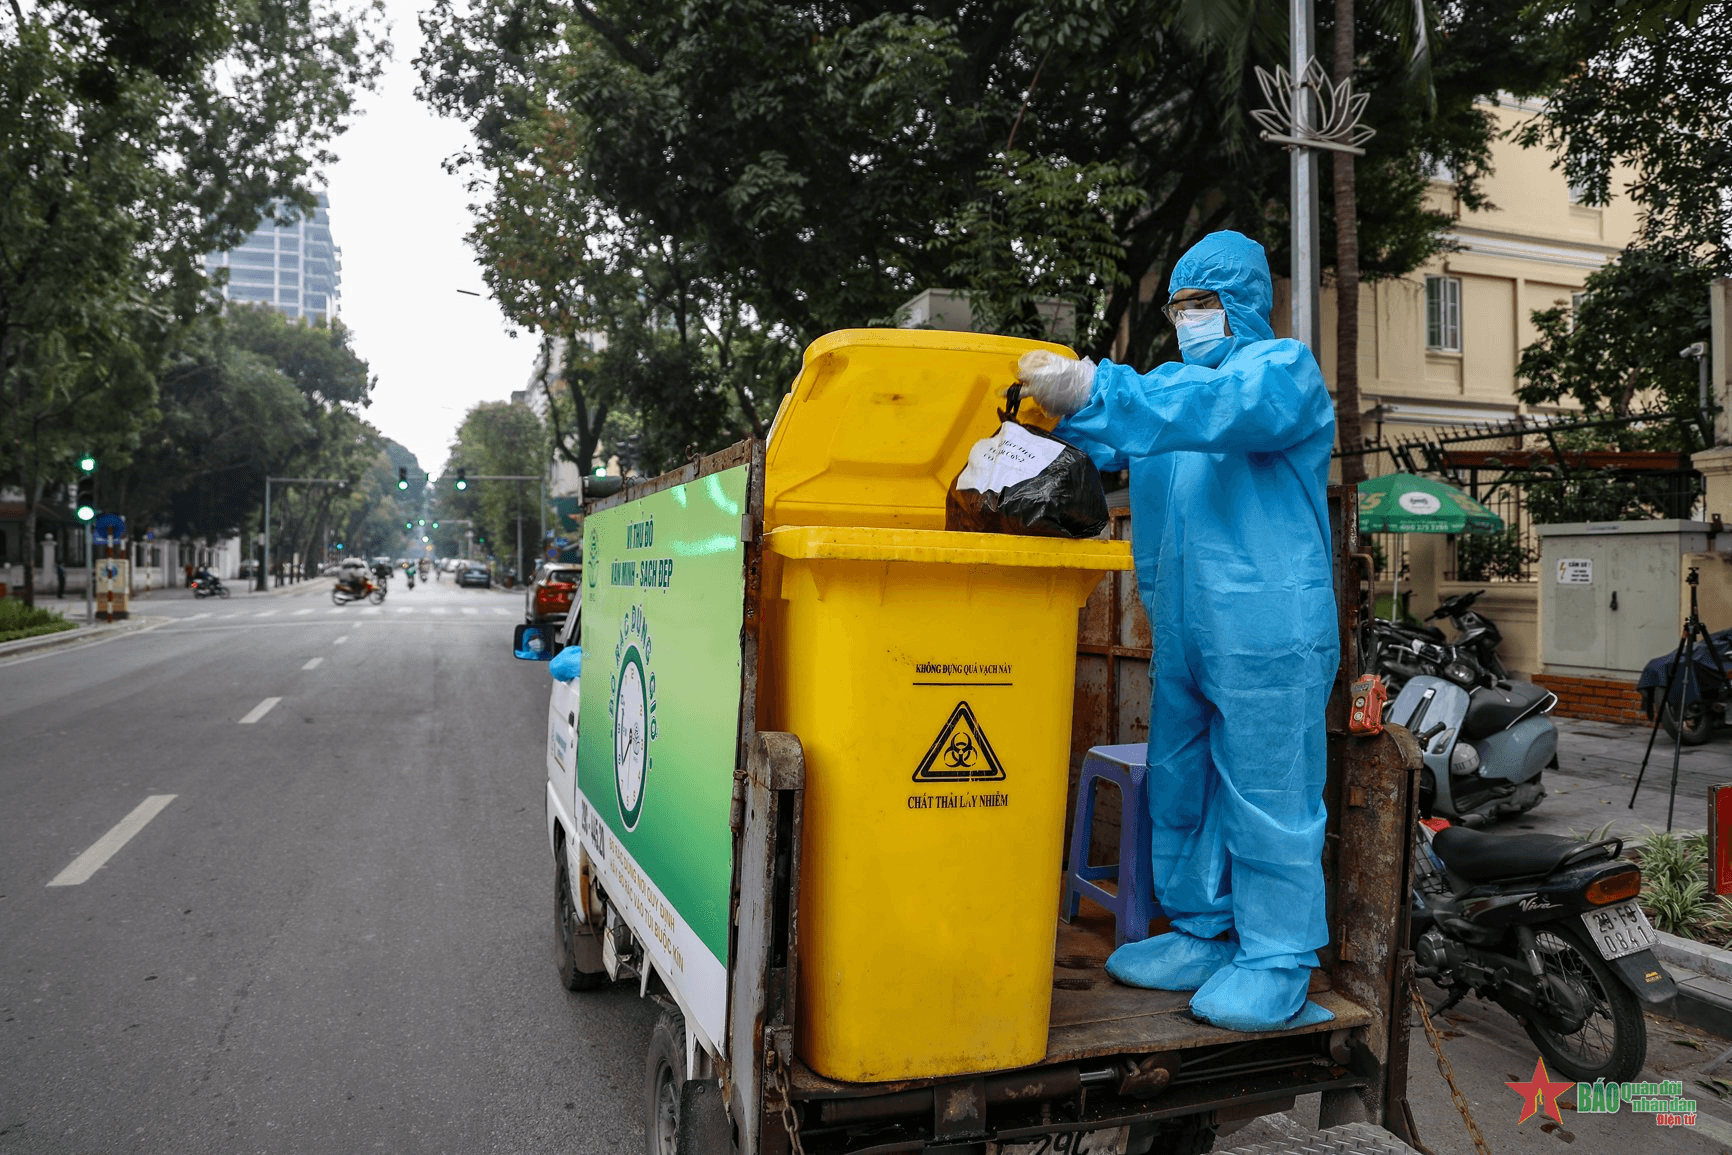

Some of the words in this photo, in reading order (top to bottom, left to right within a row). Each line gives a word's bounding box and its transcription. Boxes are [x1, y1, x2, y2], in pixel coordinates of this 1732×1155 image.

[640, 560, 658, 592] SẠCH
[658, 559, 674, 594] ĐẸP
[916, 661, 942, 674] KHÔNG
[942, 663, 962, 676] ĐỰNG
[979, 664, 998, 675] VẠCH
[907, 793, 934, 809] CHẤT
[935, 792, 958, 808] THẢI
[979, 791, 1009, 807] NHIỄM
[1518, 896, 1564, 912] Viva
[1604, 926, 1650, 953] 0841
